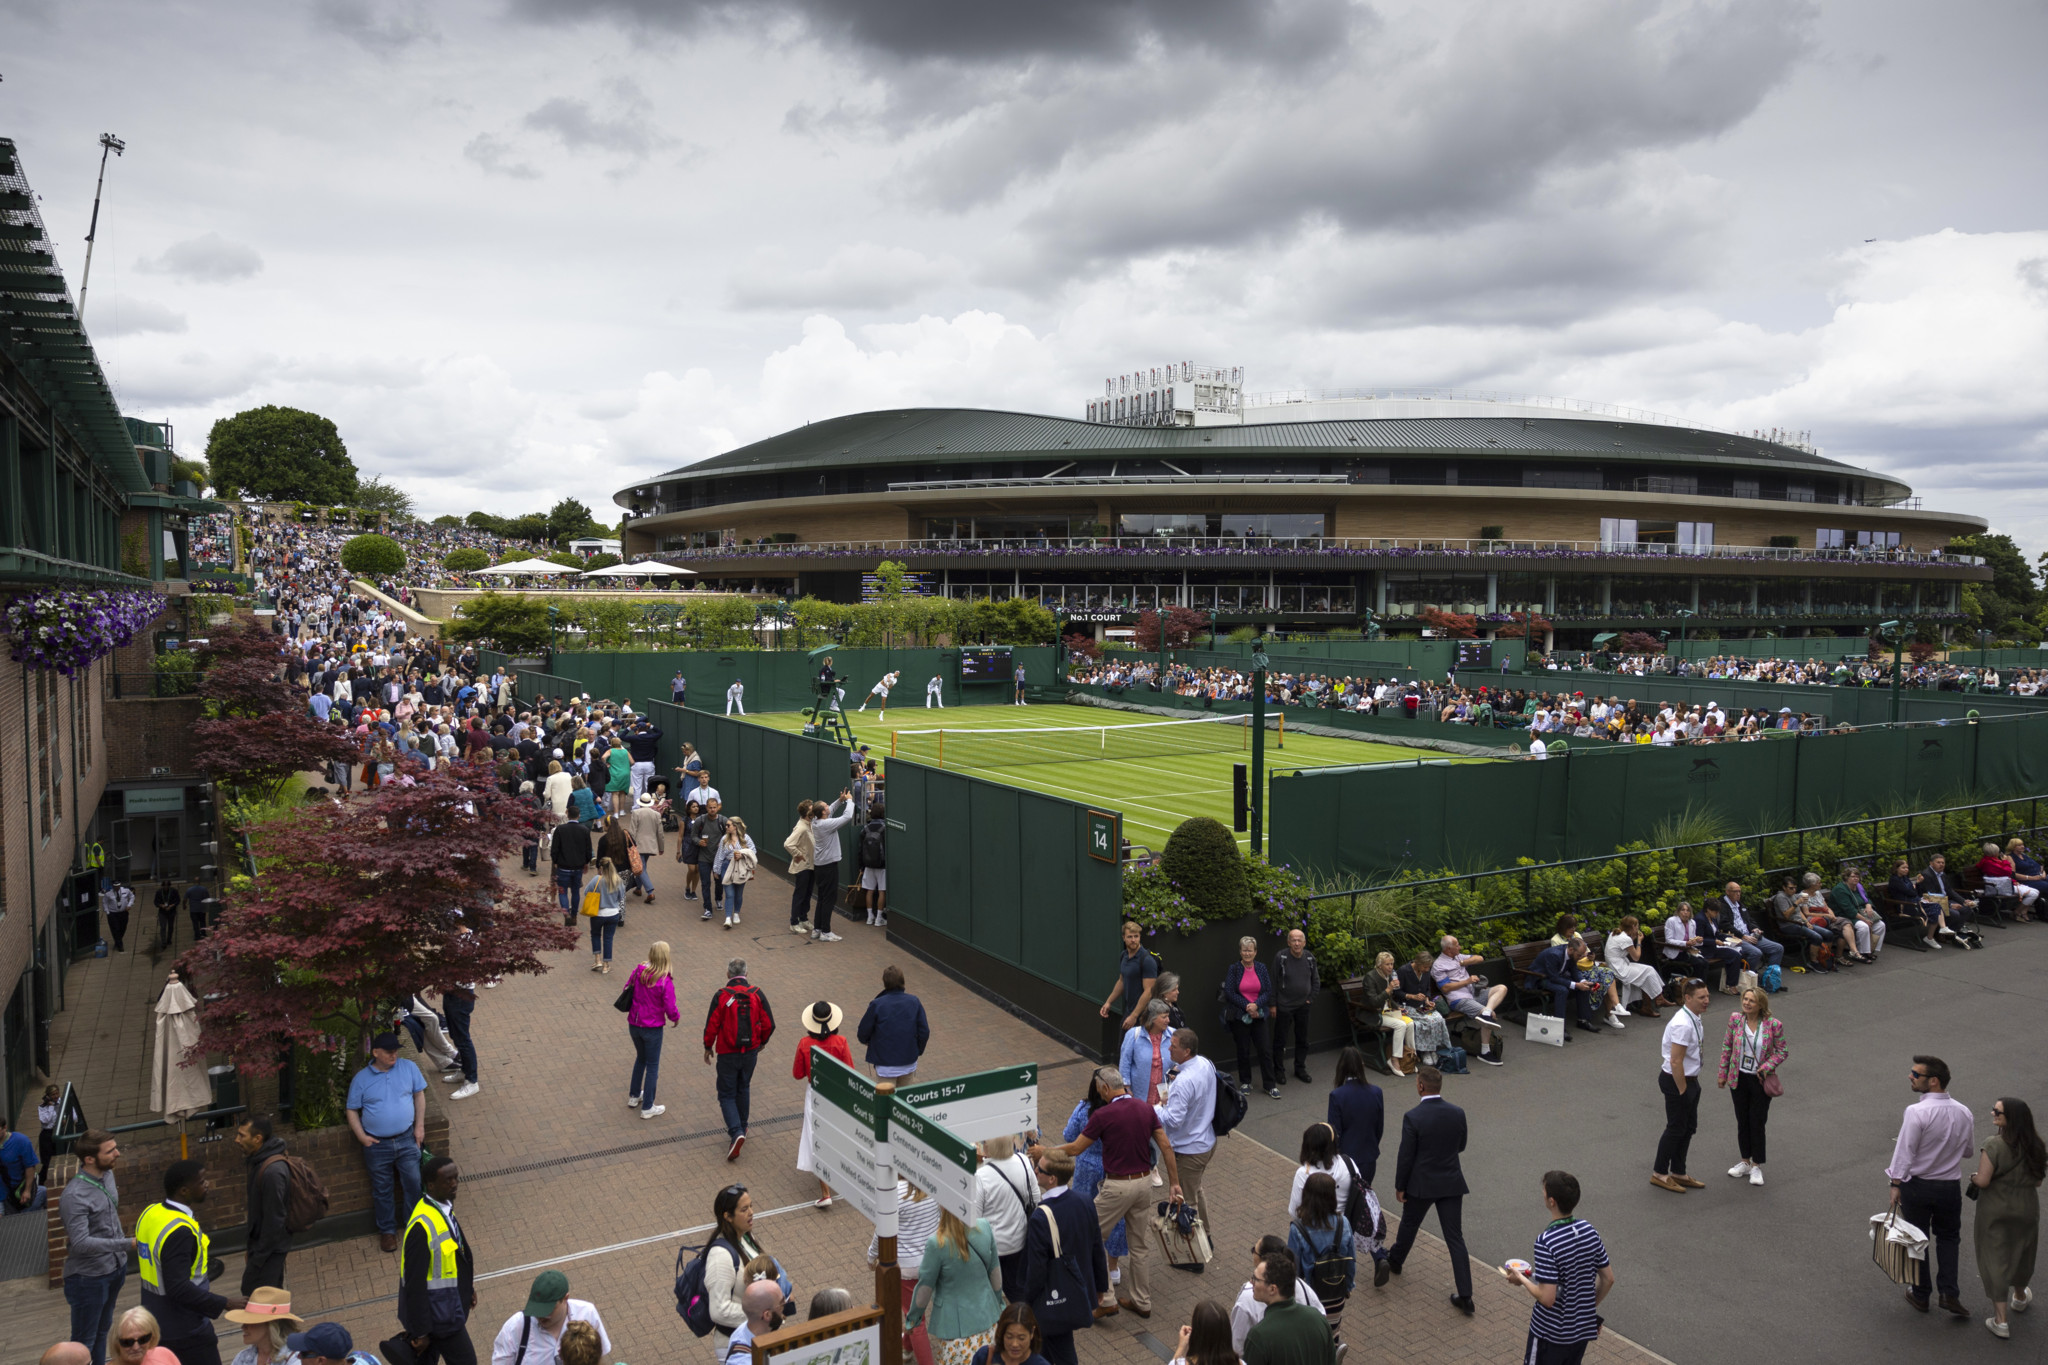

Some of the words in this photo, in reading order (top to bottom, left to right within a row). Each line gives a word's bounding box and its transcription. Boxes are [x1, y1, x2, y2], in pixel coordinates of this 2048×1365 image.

[1094, 831, 1107, 850] 14
[848, 1077, 859, 1091] No.1
[859, 1084, 874, 1102] Court
[906, 1090, 939, 1104] Courts
[941, 1083, 966, 1098] 15-17
[853, 1103, 868, 1120] Court
[892, 1106, 911, 1126] Courts
[911, 1119, 924, 1135] 2-12
[856, 1150, 866, 1165] The
[866, 1158, 875, 1172] Hill
[892, 1131, 921, 1159] Centenary
[921, 1150, 943, 1173] Garden
[840, 1161, 857, 1180] Walled
[857, 1174, 876, 1195] Garden
[892, 1154, 917, 1179] Southern
[917, 1172, 938, 1195] Village
